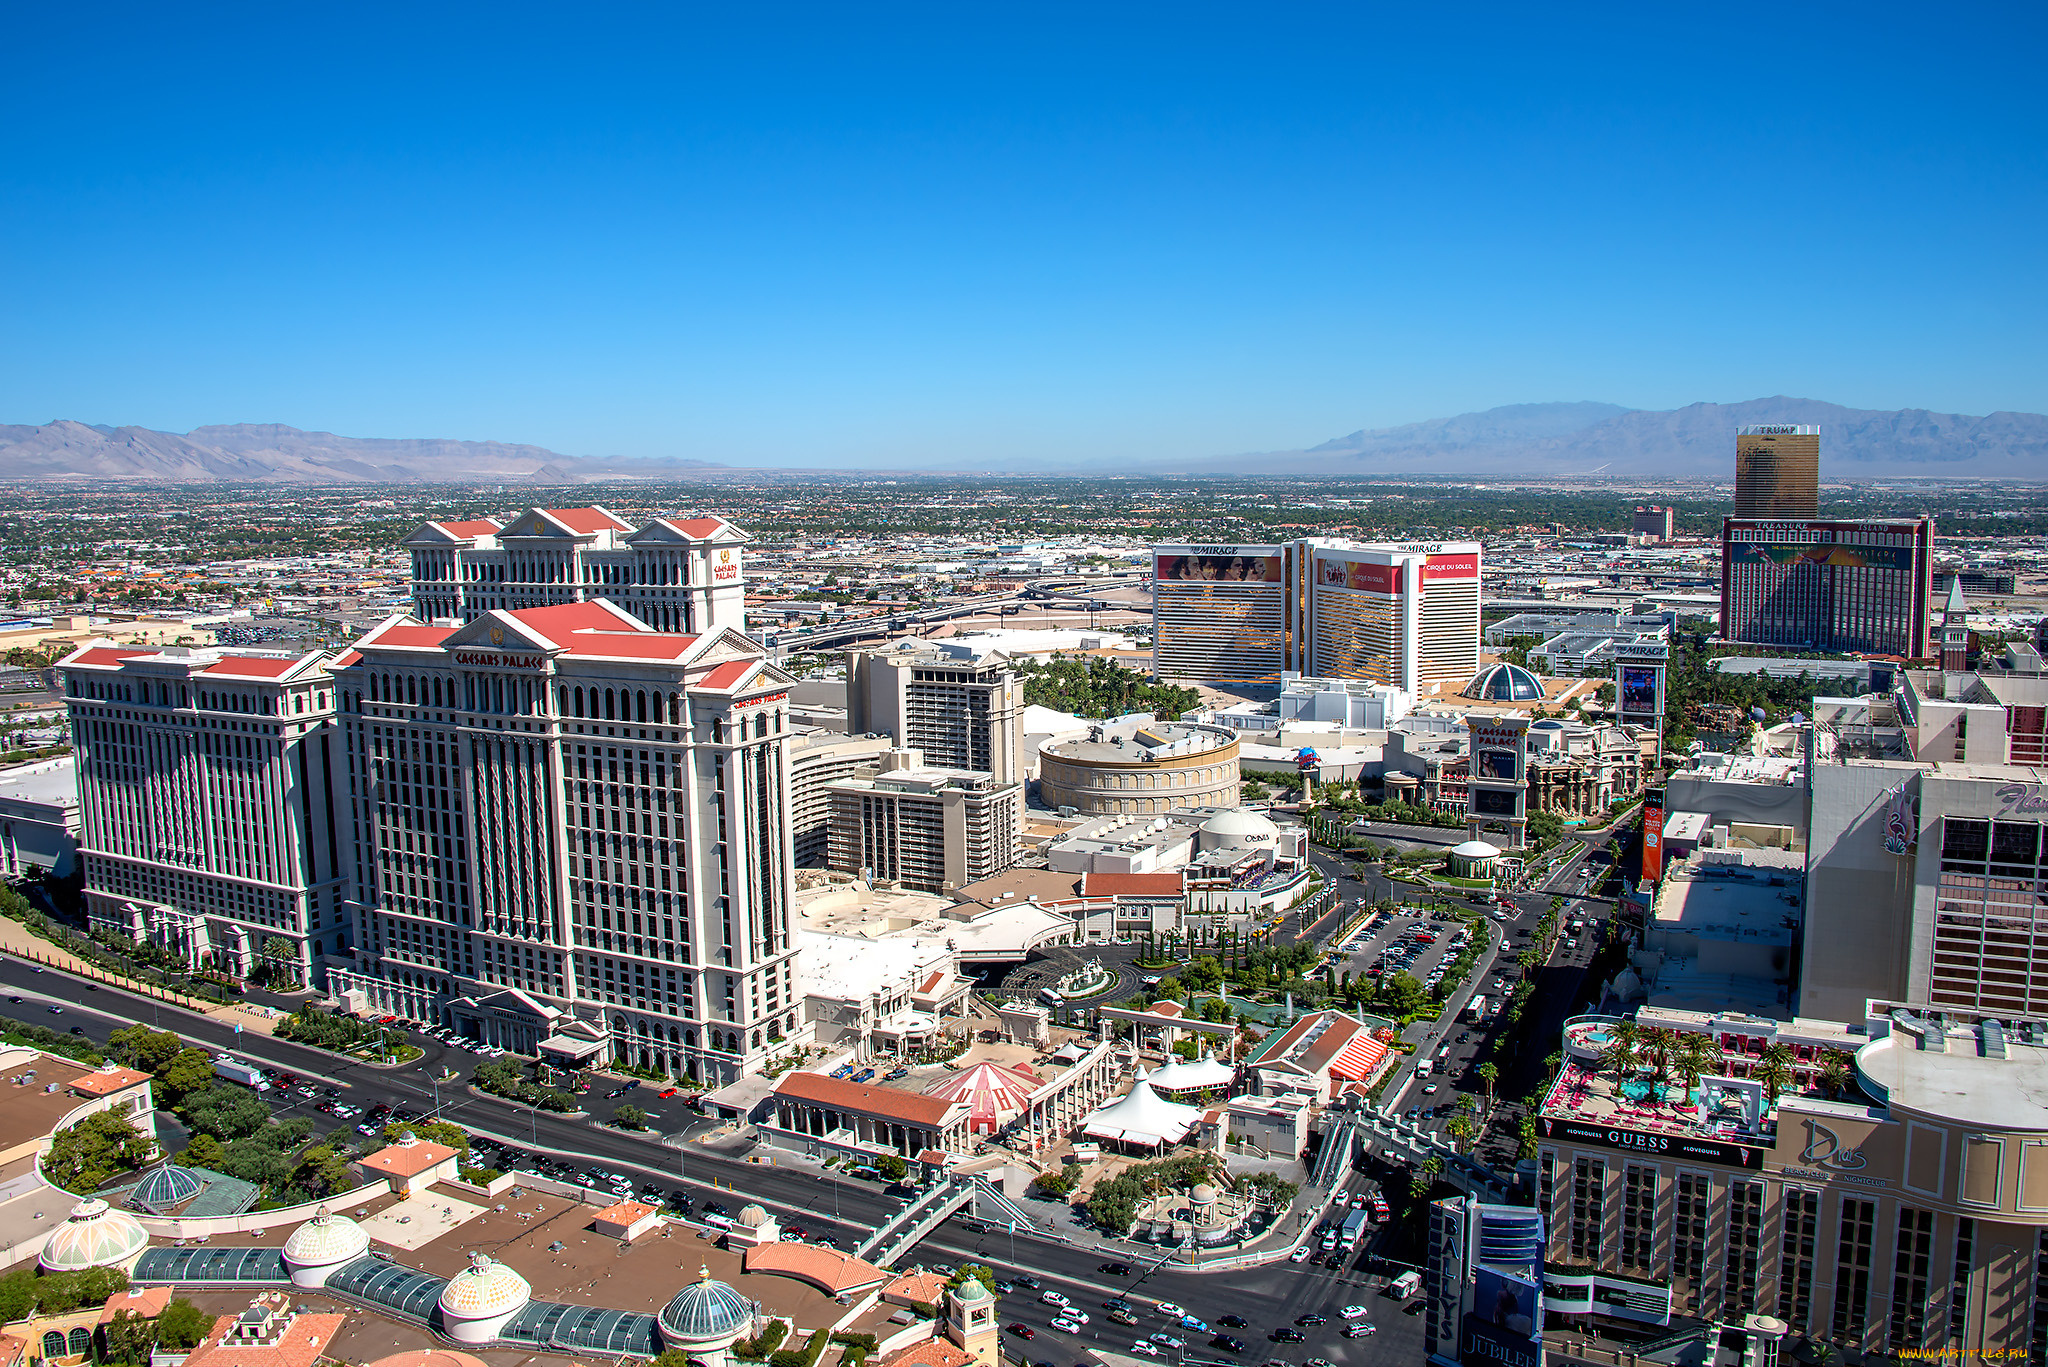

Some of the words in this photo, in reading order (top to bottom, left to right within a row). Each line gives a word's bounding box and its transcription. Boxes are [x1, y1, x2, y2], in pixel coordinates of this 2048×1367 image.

[1760, 426, 1796, 434] TRUMP
[1755, 522, 1808, 530] TREASURE
[1858, 524, 1889, 532] ISLAND
[1197, 546, 1238, 555] MIRAGE
[1406, 544, 1442, 553] MIRAGE
[714, 564, 738, 572] CAESARS
[1426, 564, 1446, 572] CIRQUE
[716, 571, 737, 580] PALACE
[1622, 646, 1666, 656] MIRAGE
[455, 652, 500, 666] CAESARS
[502, 655, 543, 669] PALACE
[733, 697, 762, 710] CAESARS
[764, 692, 787, 703] PALACE
[1477, 728, 1519, 737] CAESARS
[1478, 737, 1517, 746] PALACE
[493, 1010, 516, 1020] CAESARS
[517, 1015, 537, 1024] PALACE
[1566, 1128, 1602, 1138] #LOVEGUESS
[1608, 1130, 1669, 1149] GUESS
[1683, 1146, 1721, 1156] #LOVEGUESS
[1784, 1167, 1810, 1176] BEACH
[1811, 1170, 1830, 1179] CLUB
[1844, 1175, 1886, 1186] NIGHTCLUB
